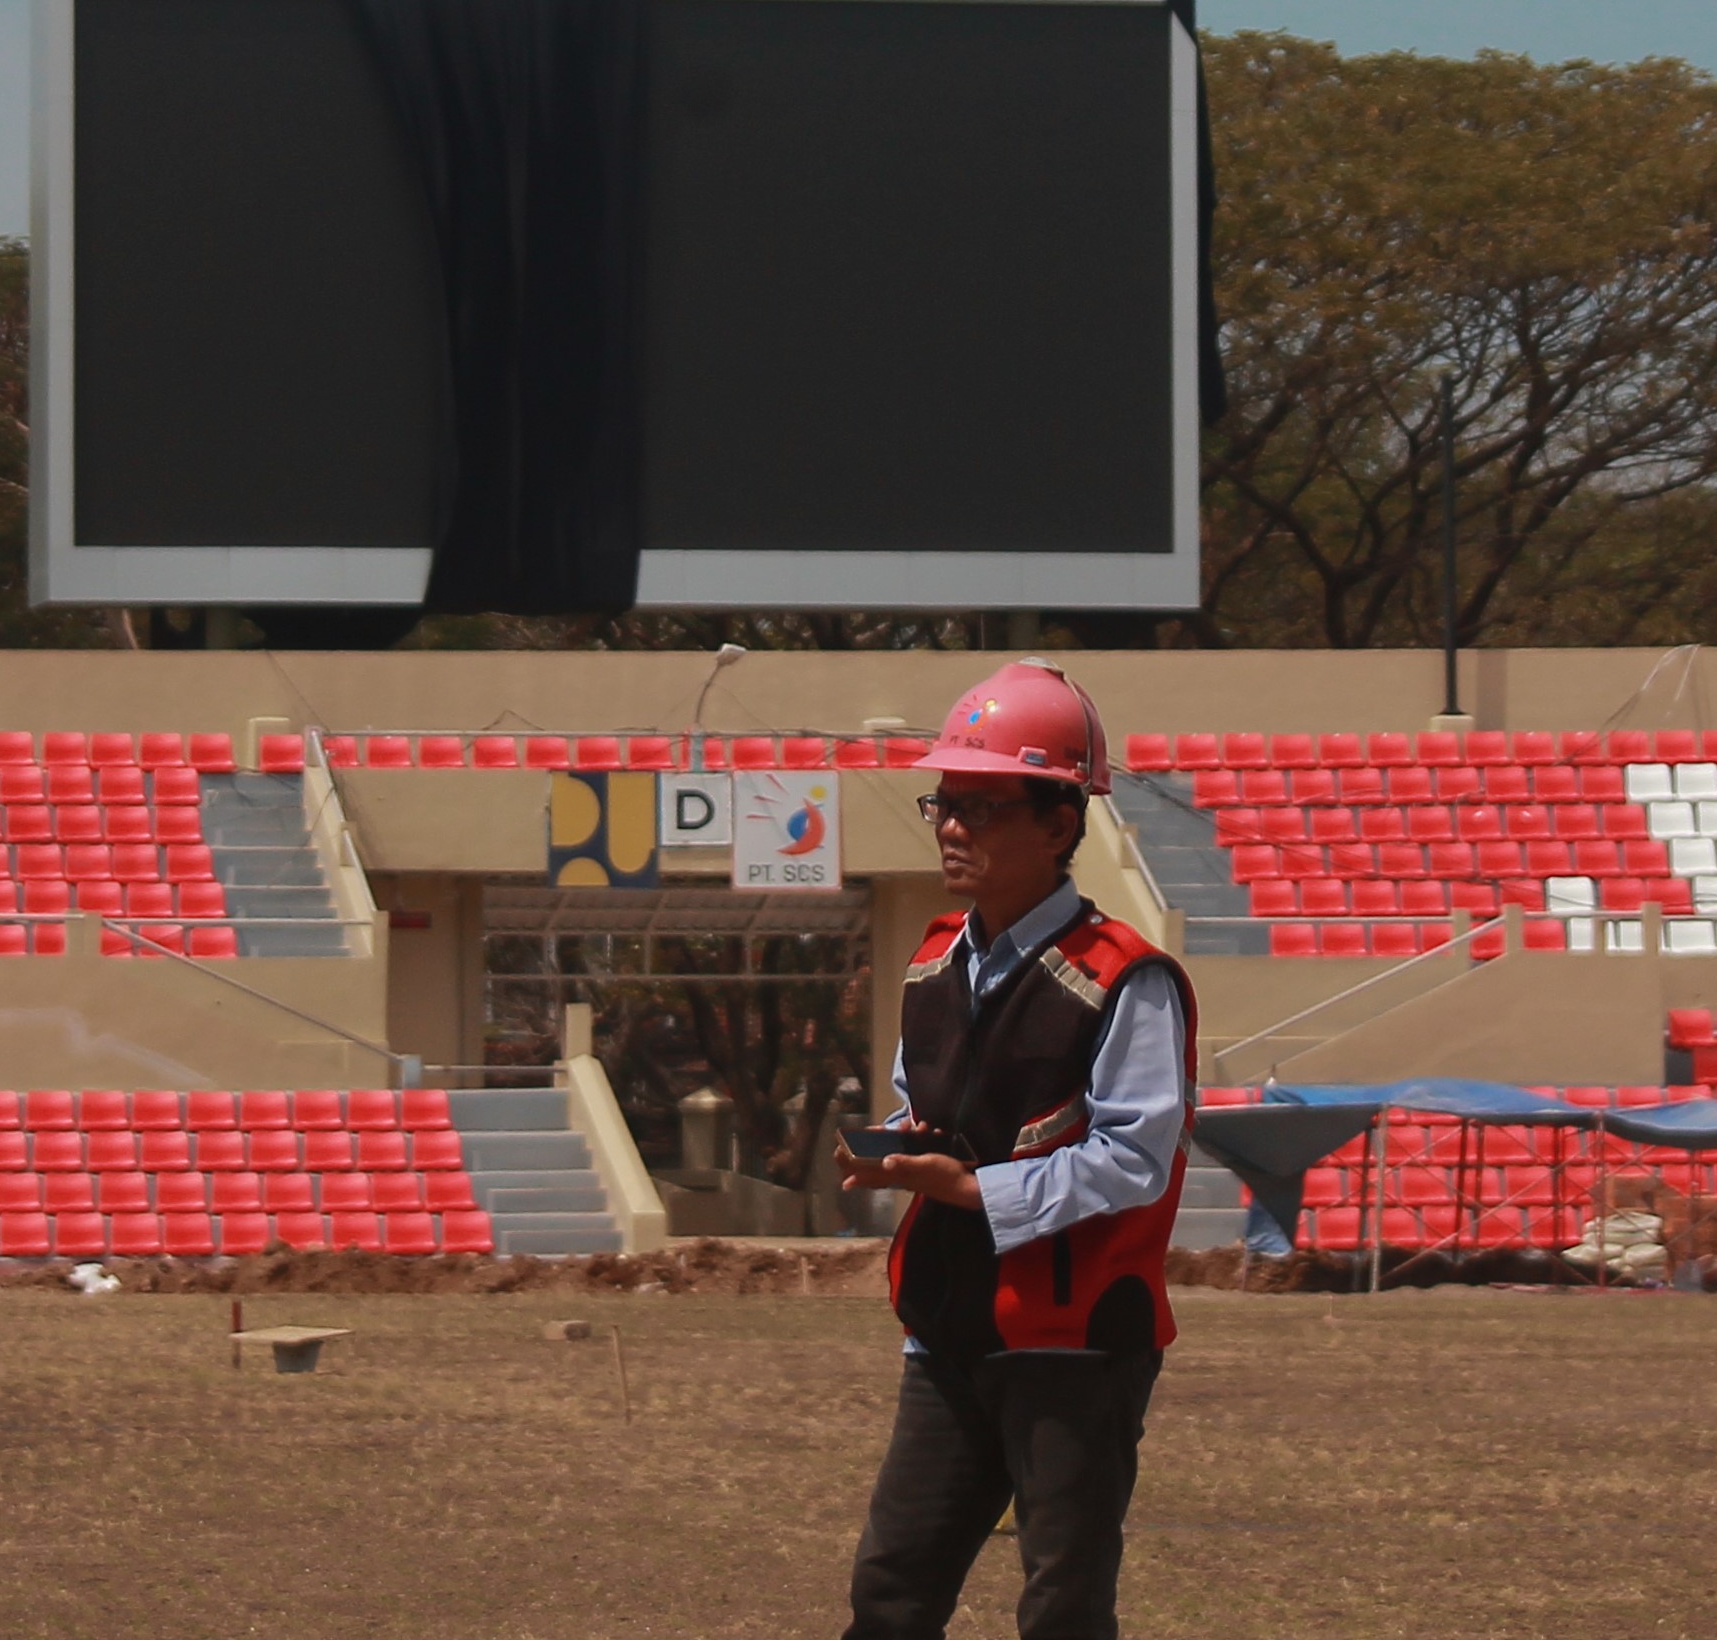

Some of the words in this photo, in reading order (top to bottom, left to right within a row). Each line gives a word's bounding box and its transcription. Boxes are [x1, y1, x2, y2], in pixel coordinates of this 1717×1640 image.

[964, 736, 986, 749] SCS
[676, 789, 715, 830] D
[748, 863, 776, 883] PT.
[783, 864, 825, 883] SCS
